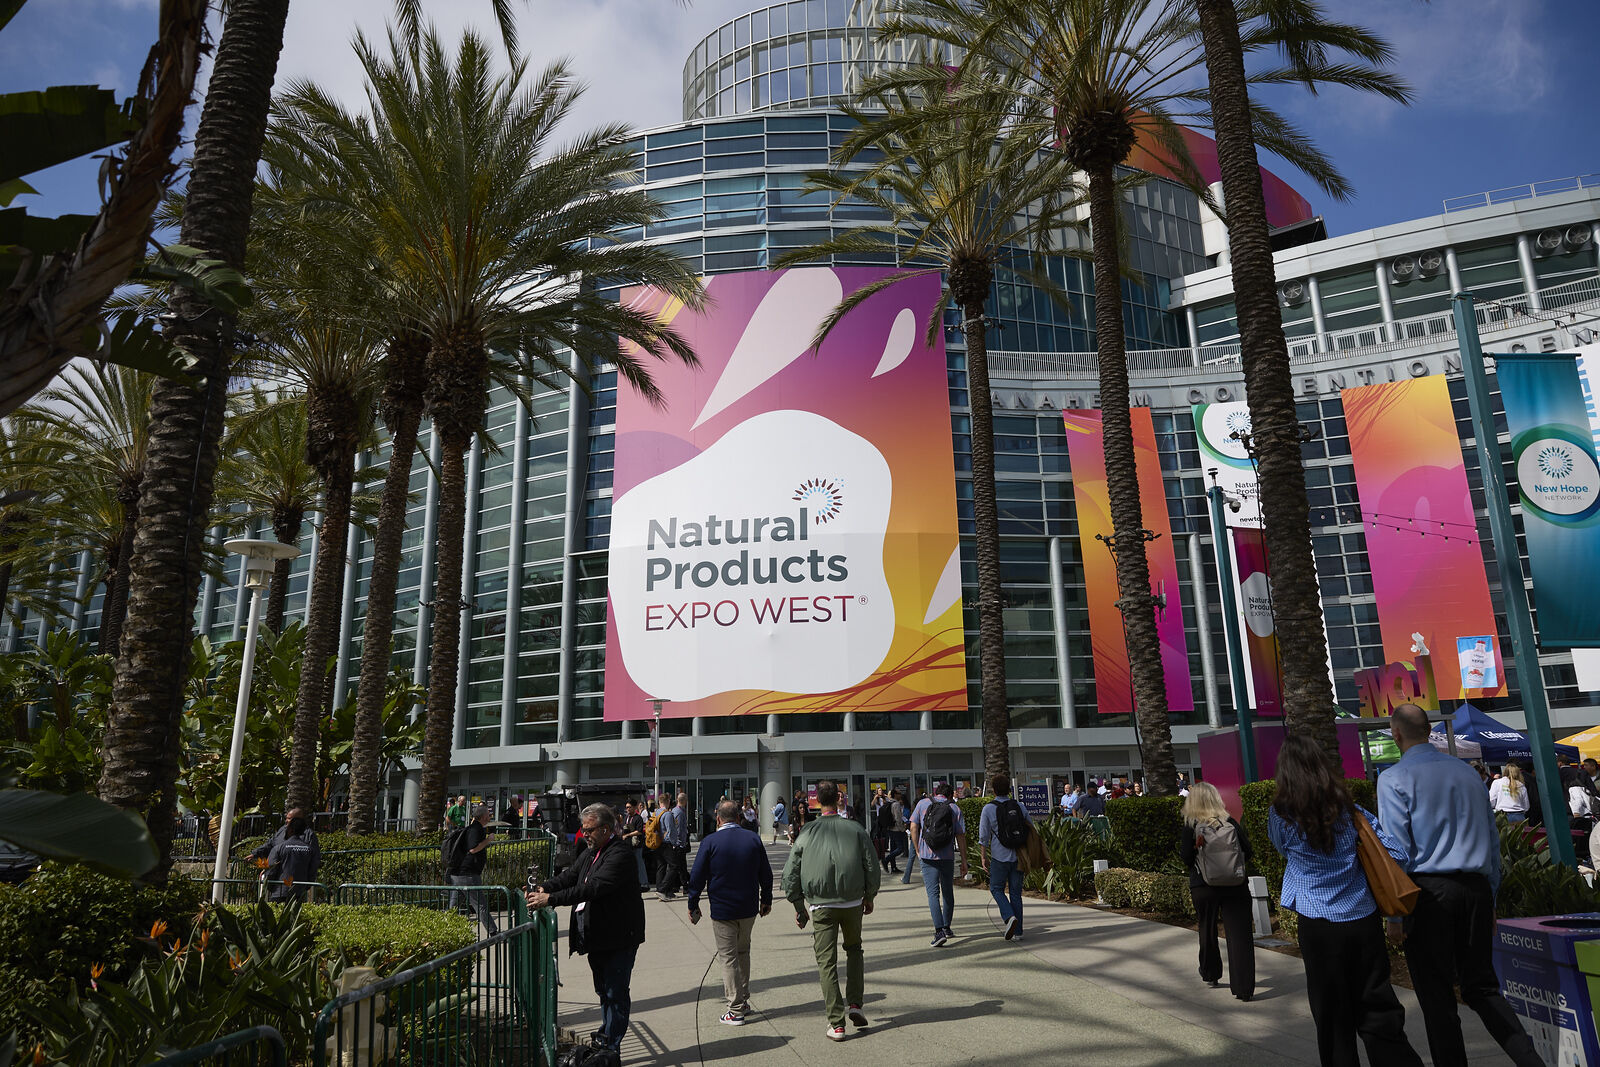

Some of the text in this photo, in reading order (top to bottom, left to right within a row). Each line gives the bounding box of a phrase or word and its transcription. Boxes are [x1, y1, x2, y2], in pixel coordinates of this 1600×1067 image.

[990, 391, 1150, 408] ANAHEM
[1187, 355, 1464, 404] COENTION
[1534, 484, 1589, 494] New Hope
[647, 507, 808, 550] Natural
[646, 549, 848, 592] Products
[645, 600, 740, 631] EXPO
[1249, 603, 1270, 611] Produ
[1500, 932, 1544, 952] RECYCLE
[1505, 979, 1567, 1009] RECYCLING
